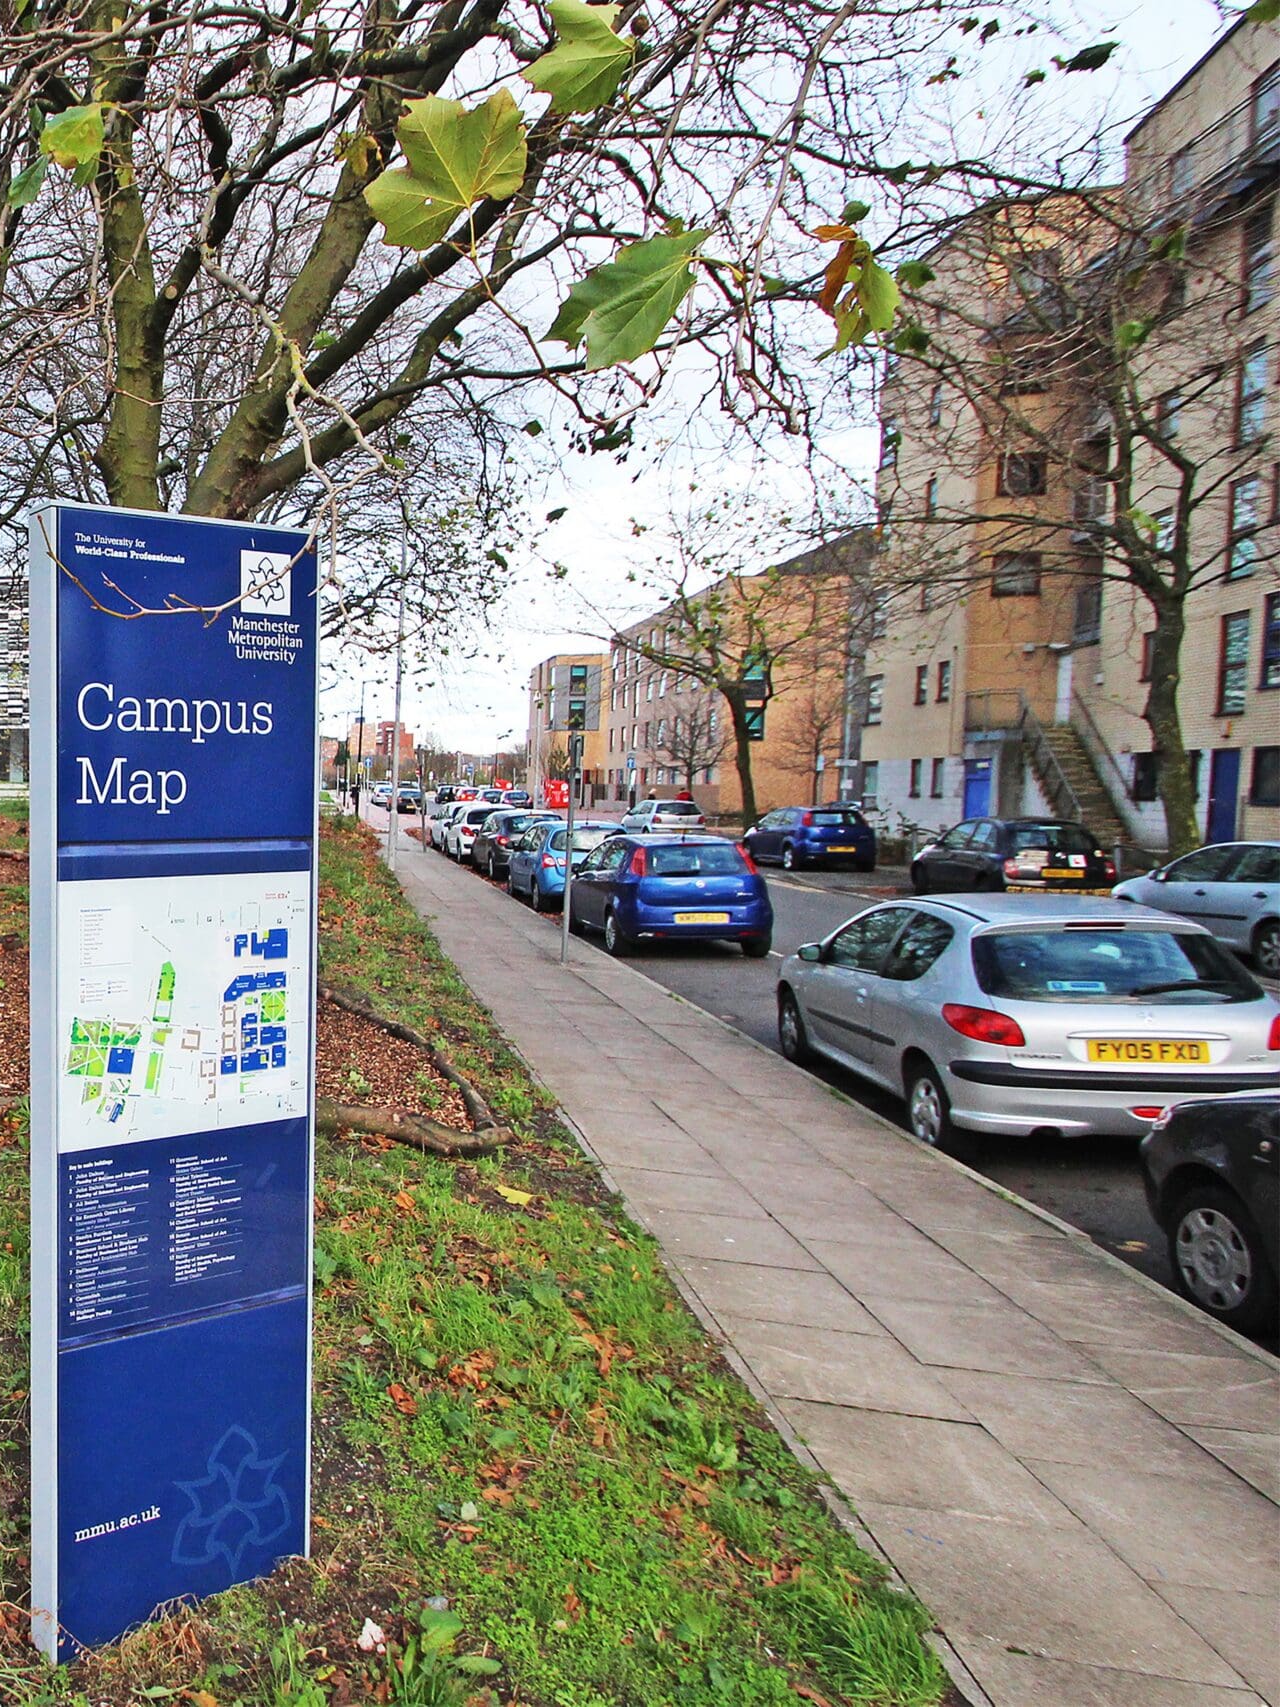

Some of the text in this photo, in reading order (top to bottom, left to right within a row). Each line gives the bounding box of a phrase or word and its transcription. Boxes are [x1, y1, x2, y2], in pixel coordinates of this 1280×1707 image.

[75, 532, 146, 548] The University for
[75, 546, 185, 563] World-Class Professionals
[232, 616, 300, 633] Manchester
[228, 631, 303, 649] Metropolitan
[235, 646, 295, 665] University
[77, 682, 273, 743] Campus
[76, 757, 187, 814] Map
[1096, 1043, 1201, 1060] FY05 FXD
[74, 1505, 161, 1542] mmu.ac.uk
